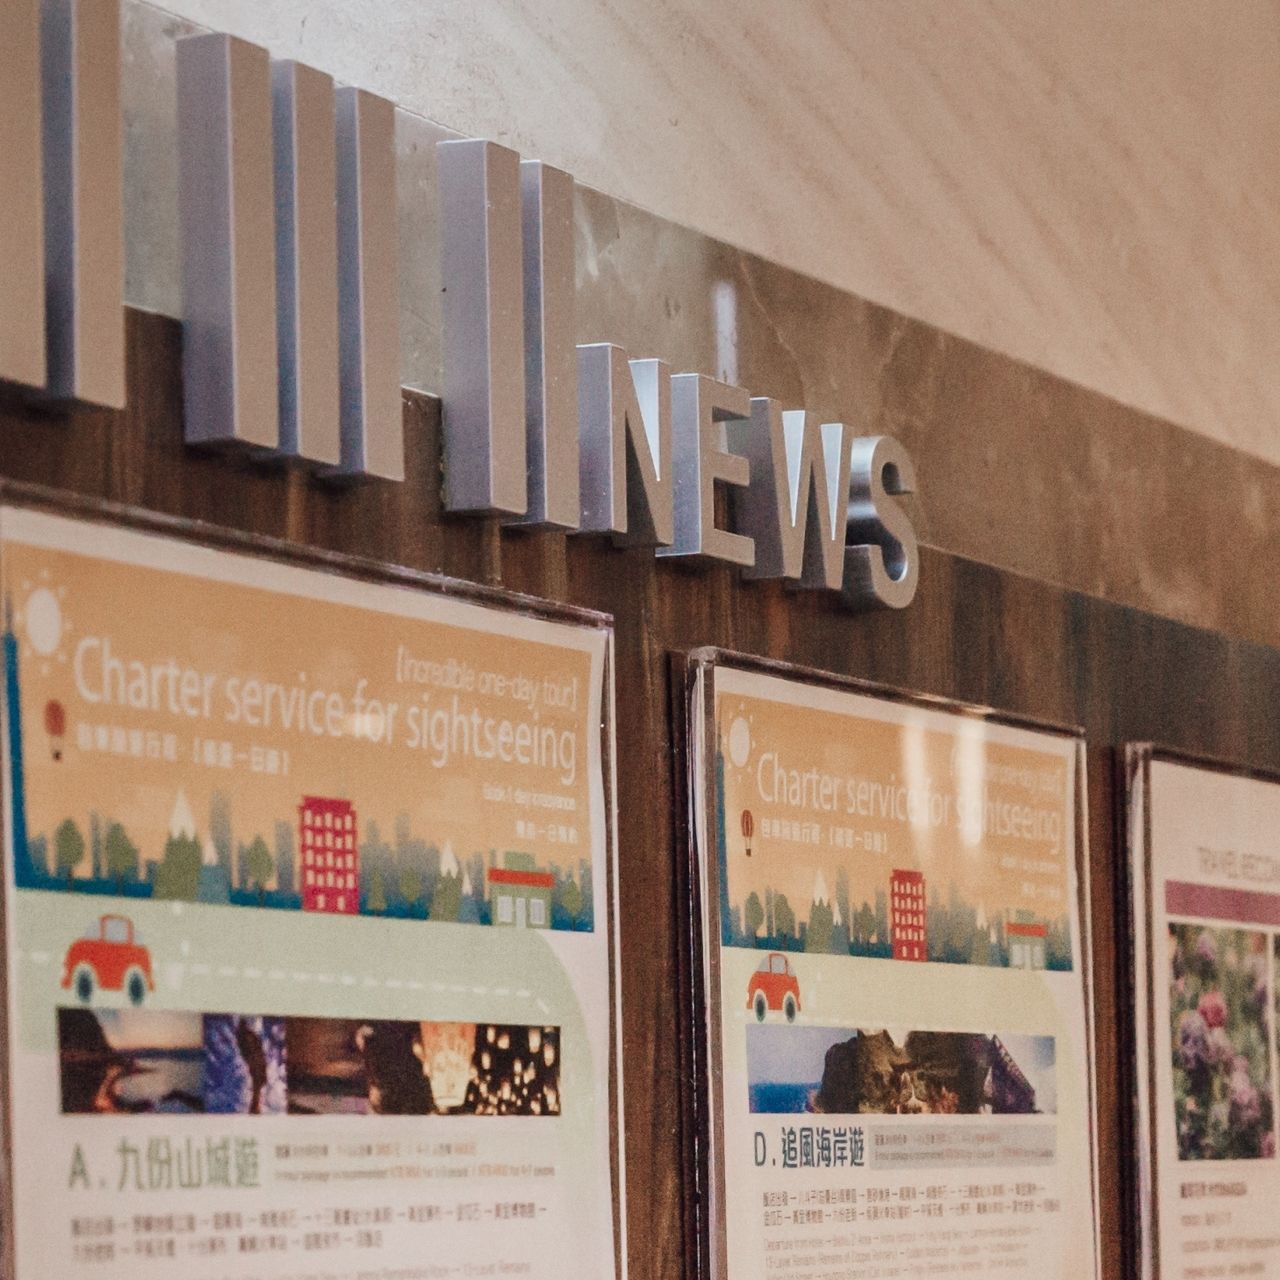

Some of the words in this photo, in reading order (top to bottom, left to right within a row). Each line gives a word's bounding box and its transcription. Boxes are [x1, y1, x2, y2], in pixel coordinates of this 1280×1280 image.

[576, 342, 918, 609] NEWS
[74, 636, 217, 720] Charter
[224, 671, 344, 737] service
[351, 678, 398, 744] for
[405, 692, 577, 786] sightseeing
[757, 752, 842, 811] Charter
[781, 1126, 865, 1168] 追風海岸遊
